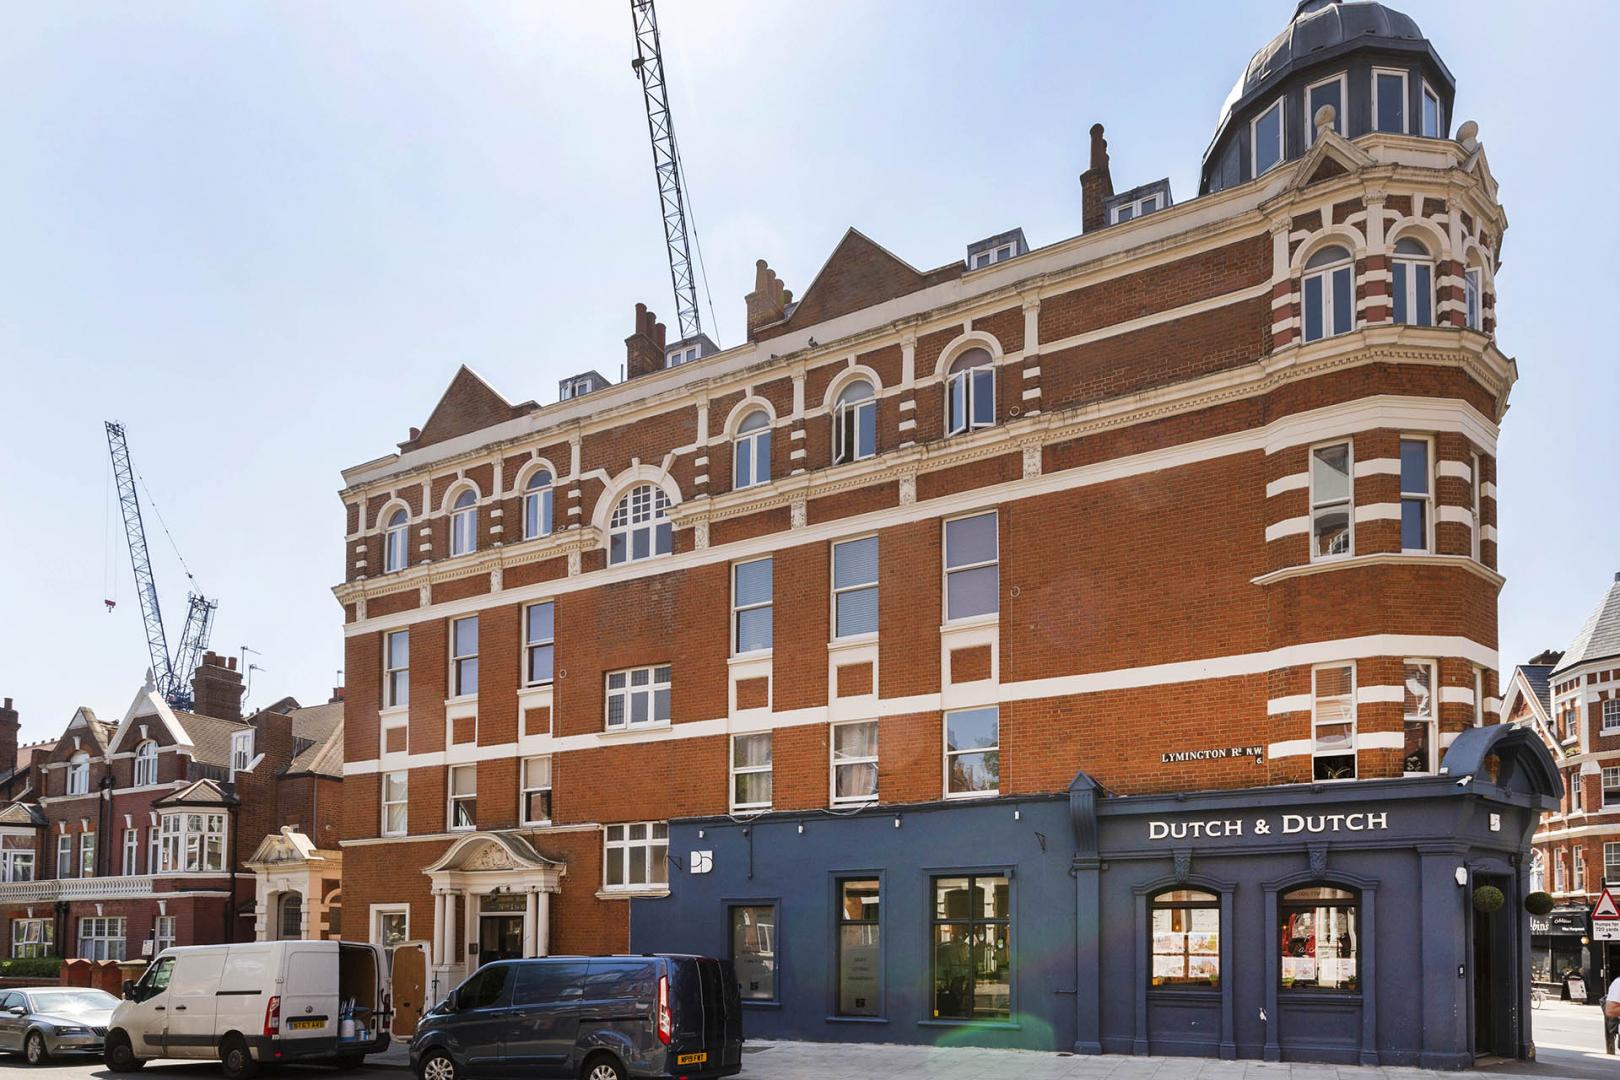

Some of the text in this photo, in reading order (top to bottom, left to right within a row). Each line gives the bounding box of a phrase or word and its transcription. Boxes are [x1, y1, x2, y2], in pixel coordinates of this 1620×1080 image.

[1161, 748, 1226, 763] LYMINGTON
[1149, 812, 1388, 839] DUTCH & DUTCH
